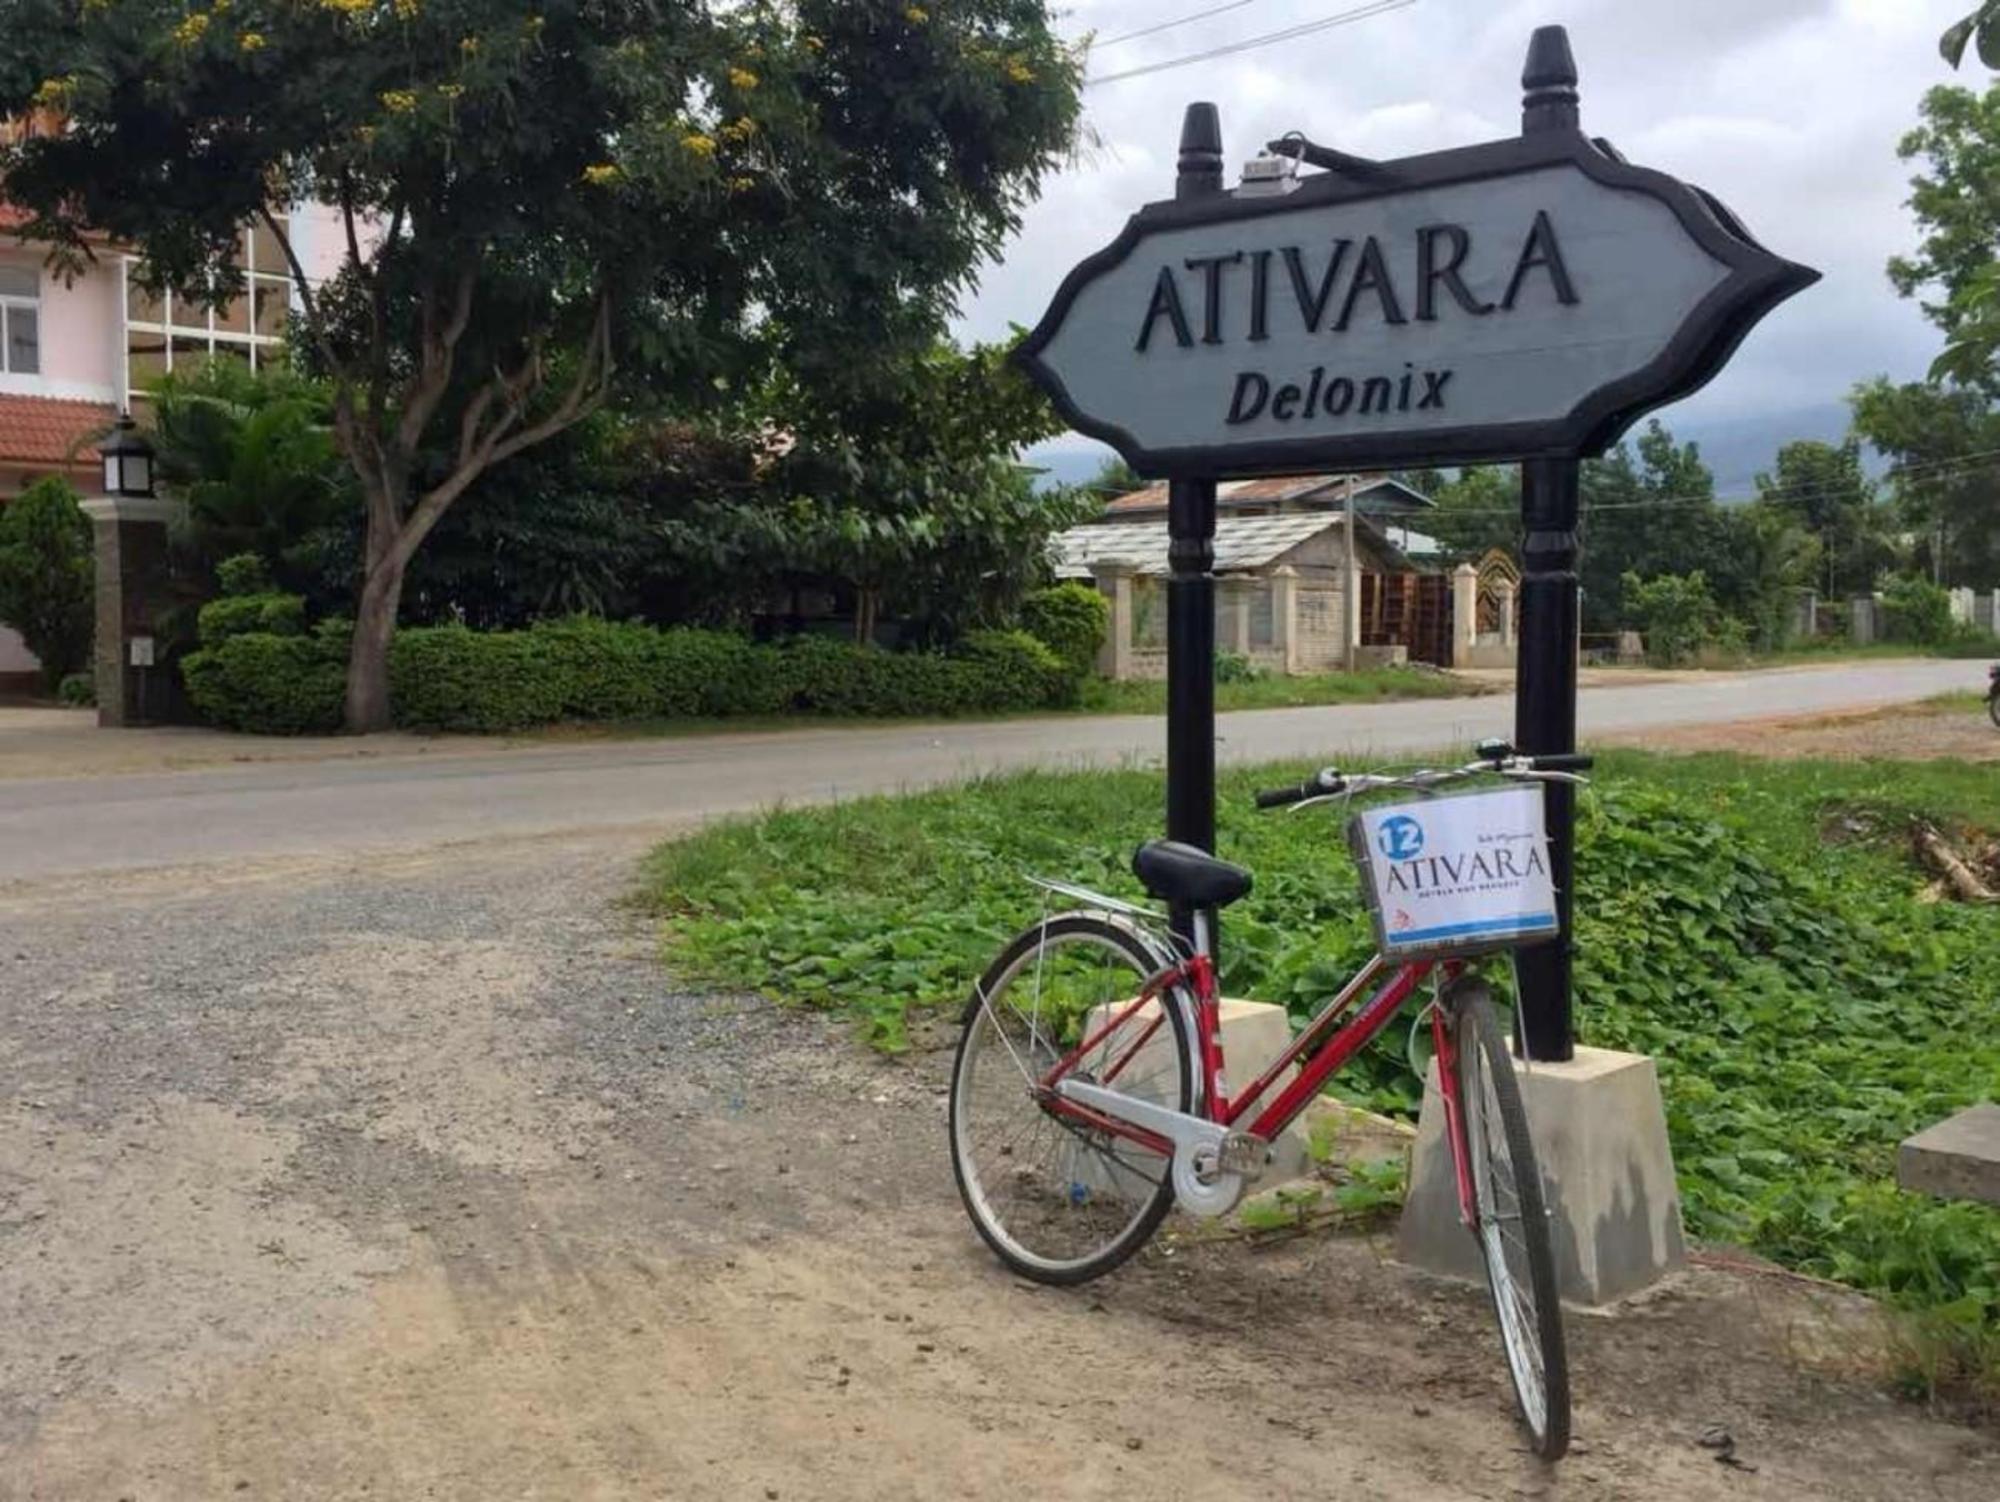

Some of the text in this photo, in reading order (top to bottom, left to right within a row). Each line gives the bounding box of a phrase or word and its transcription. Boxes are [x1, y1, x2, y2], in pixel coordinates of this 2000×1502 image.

[1134, 209, 1581, 353] ATIVARA
[1225, 363, 1453, 425] Delonix
[1387, 846, 1545, 893] ATIVARA
